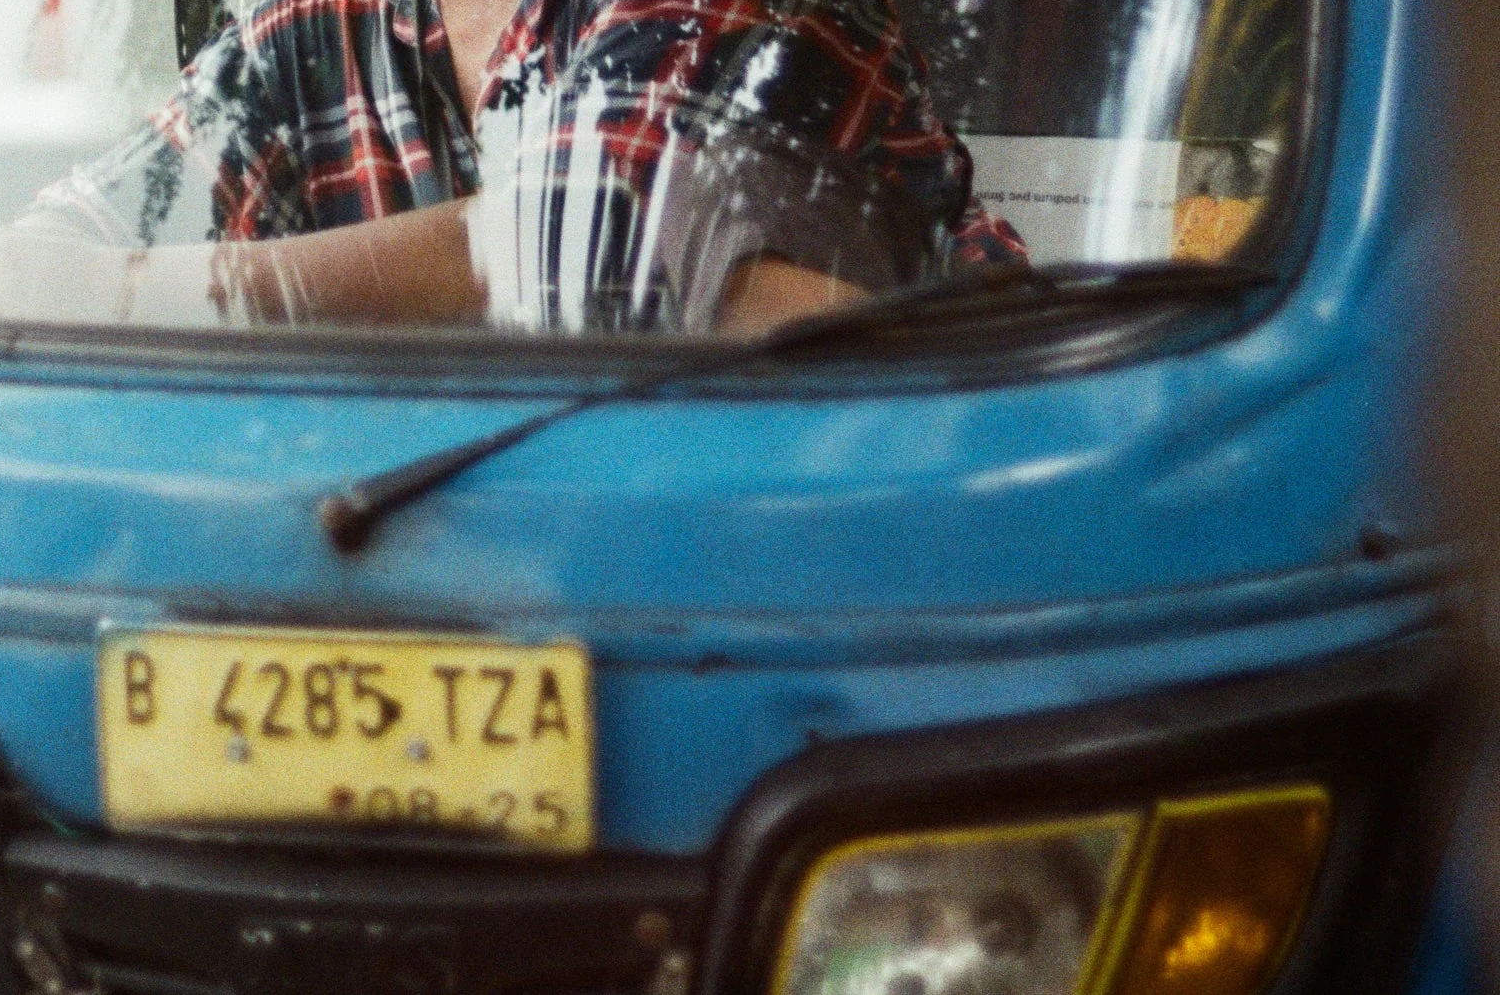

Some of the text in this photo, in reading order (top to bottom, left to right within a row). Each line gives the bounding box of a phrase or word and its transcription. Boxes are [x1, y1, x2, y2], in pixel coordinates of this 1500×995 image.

[124, 650, 569, 745] B 4285 TZA
